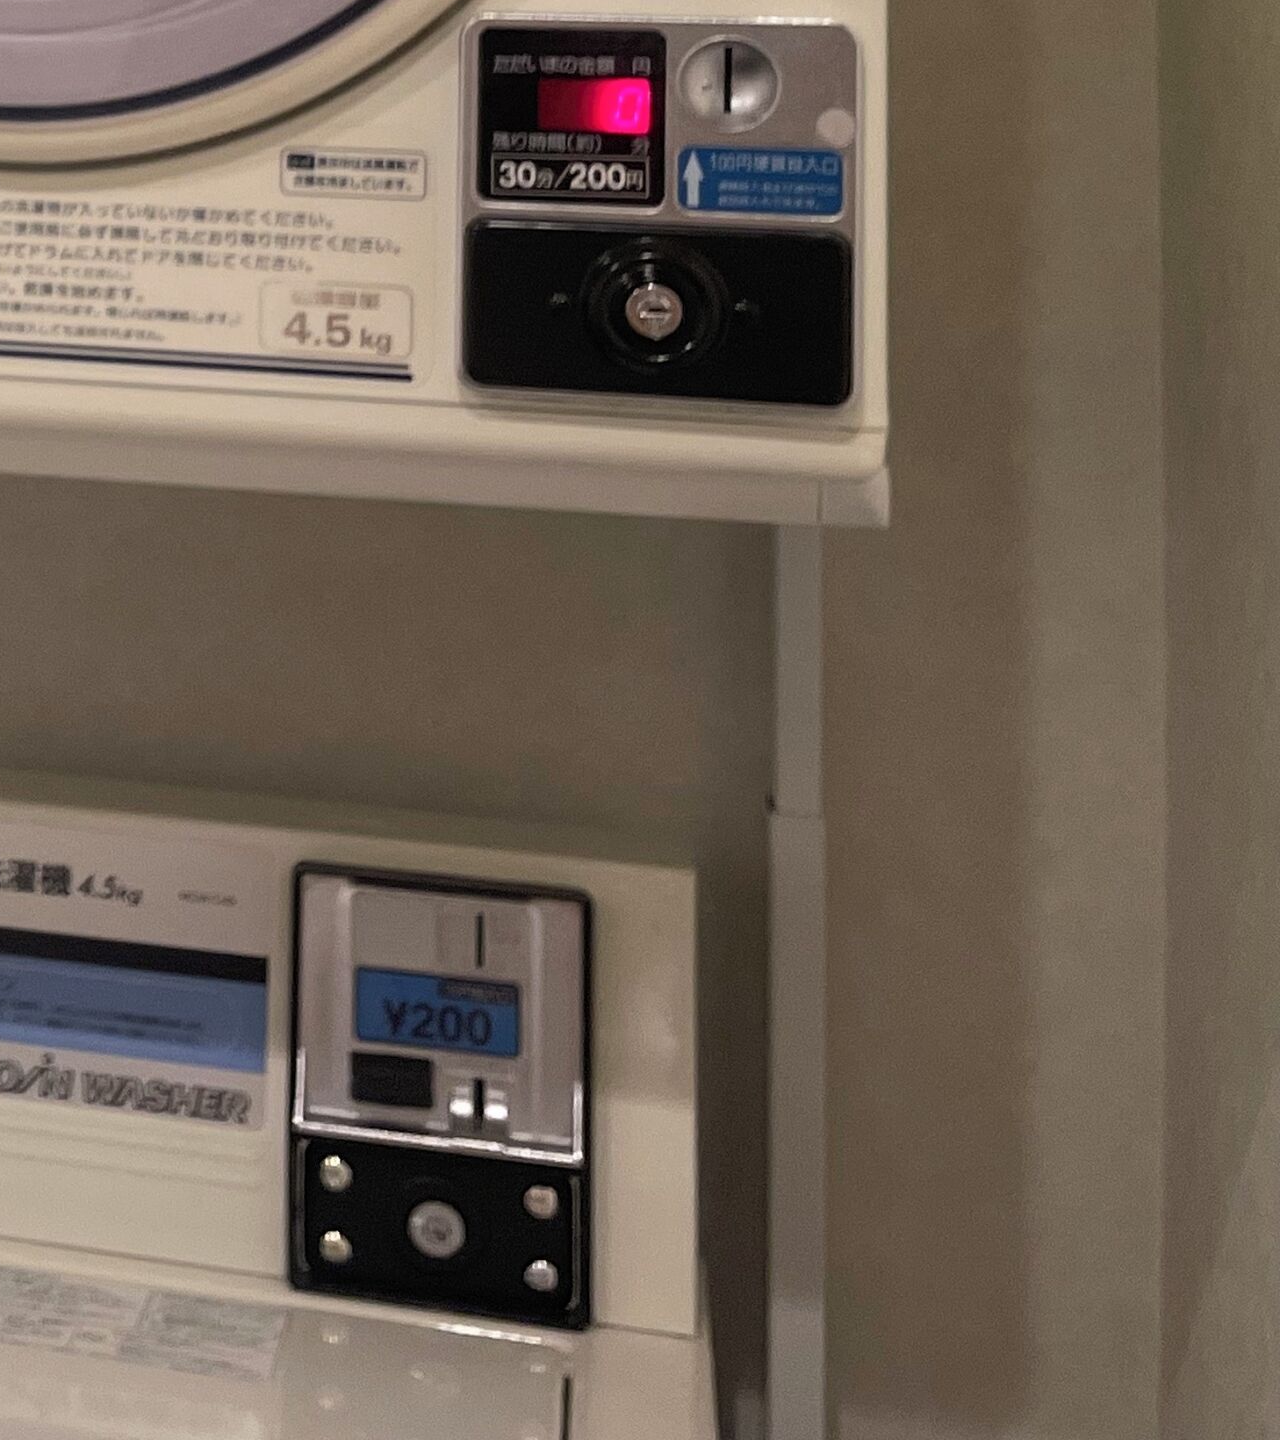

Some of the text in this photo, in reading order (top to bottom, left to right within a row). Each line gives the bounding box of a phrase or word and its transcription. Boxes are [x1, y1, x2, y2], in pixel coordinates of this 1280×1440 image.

[614, 86, 643, 128] 0
[77, 872, 145, 908] 4.5kg
[383, 993, 494, 1048] ¥200
[80, 1070, 254, 1125] WASHER
